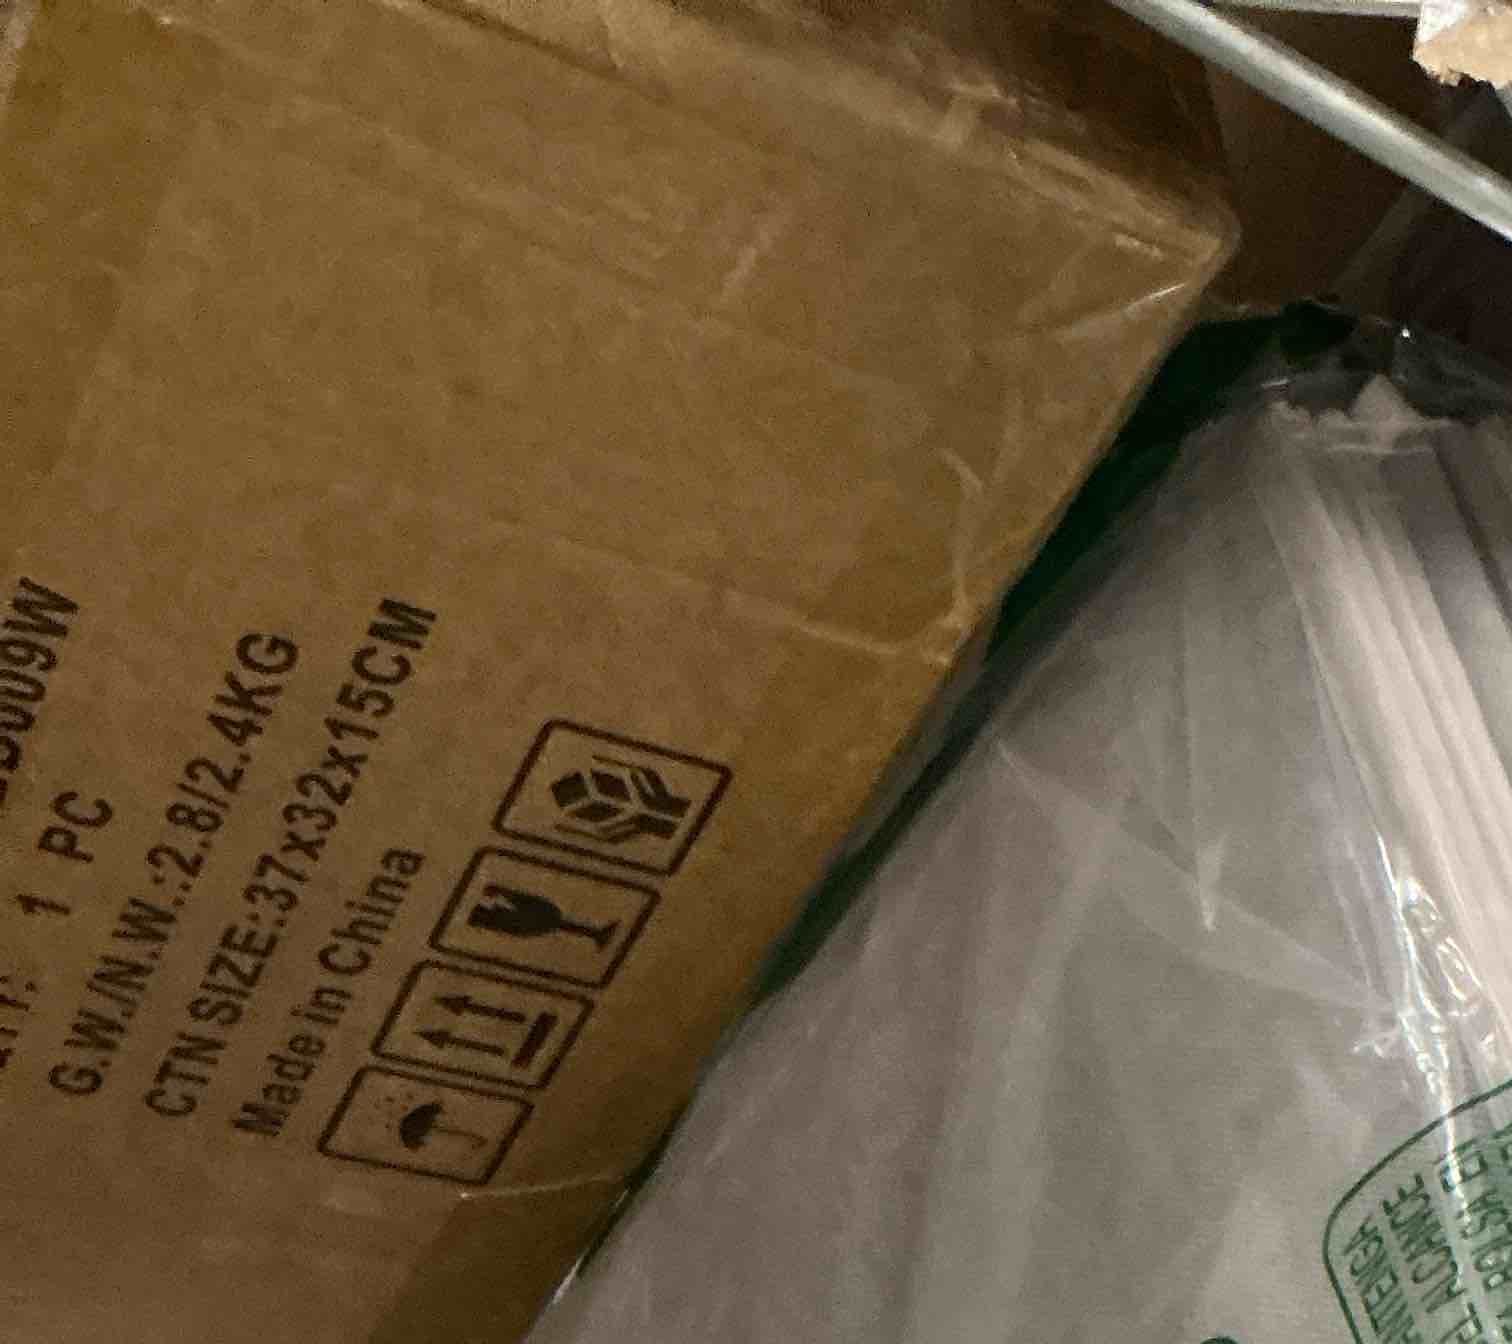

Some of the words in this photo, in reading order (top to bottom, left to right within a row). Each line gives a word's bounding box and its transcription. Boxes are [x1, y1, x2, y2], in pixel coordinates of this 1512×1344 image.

[37, 790, 114, 864] PC
[16, 892, 71, 916] 1
[318, 847, 428, 978] China
[290, 984, 353, 1029] in
[144, 1030, 227, 1118] CTN
[228, 1030, 327, 1138] Made
[1382, 1172, 1466, 1314] ALCANCE
